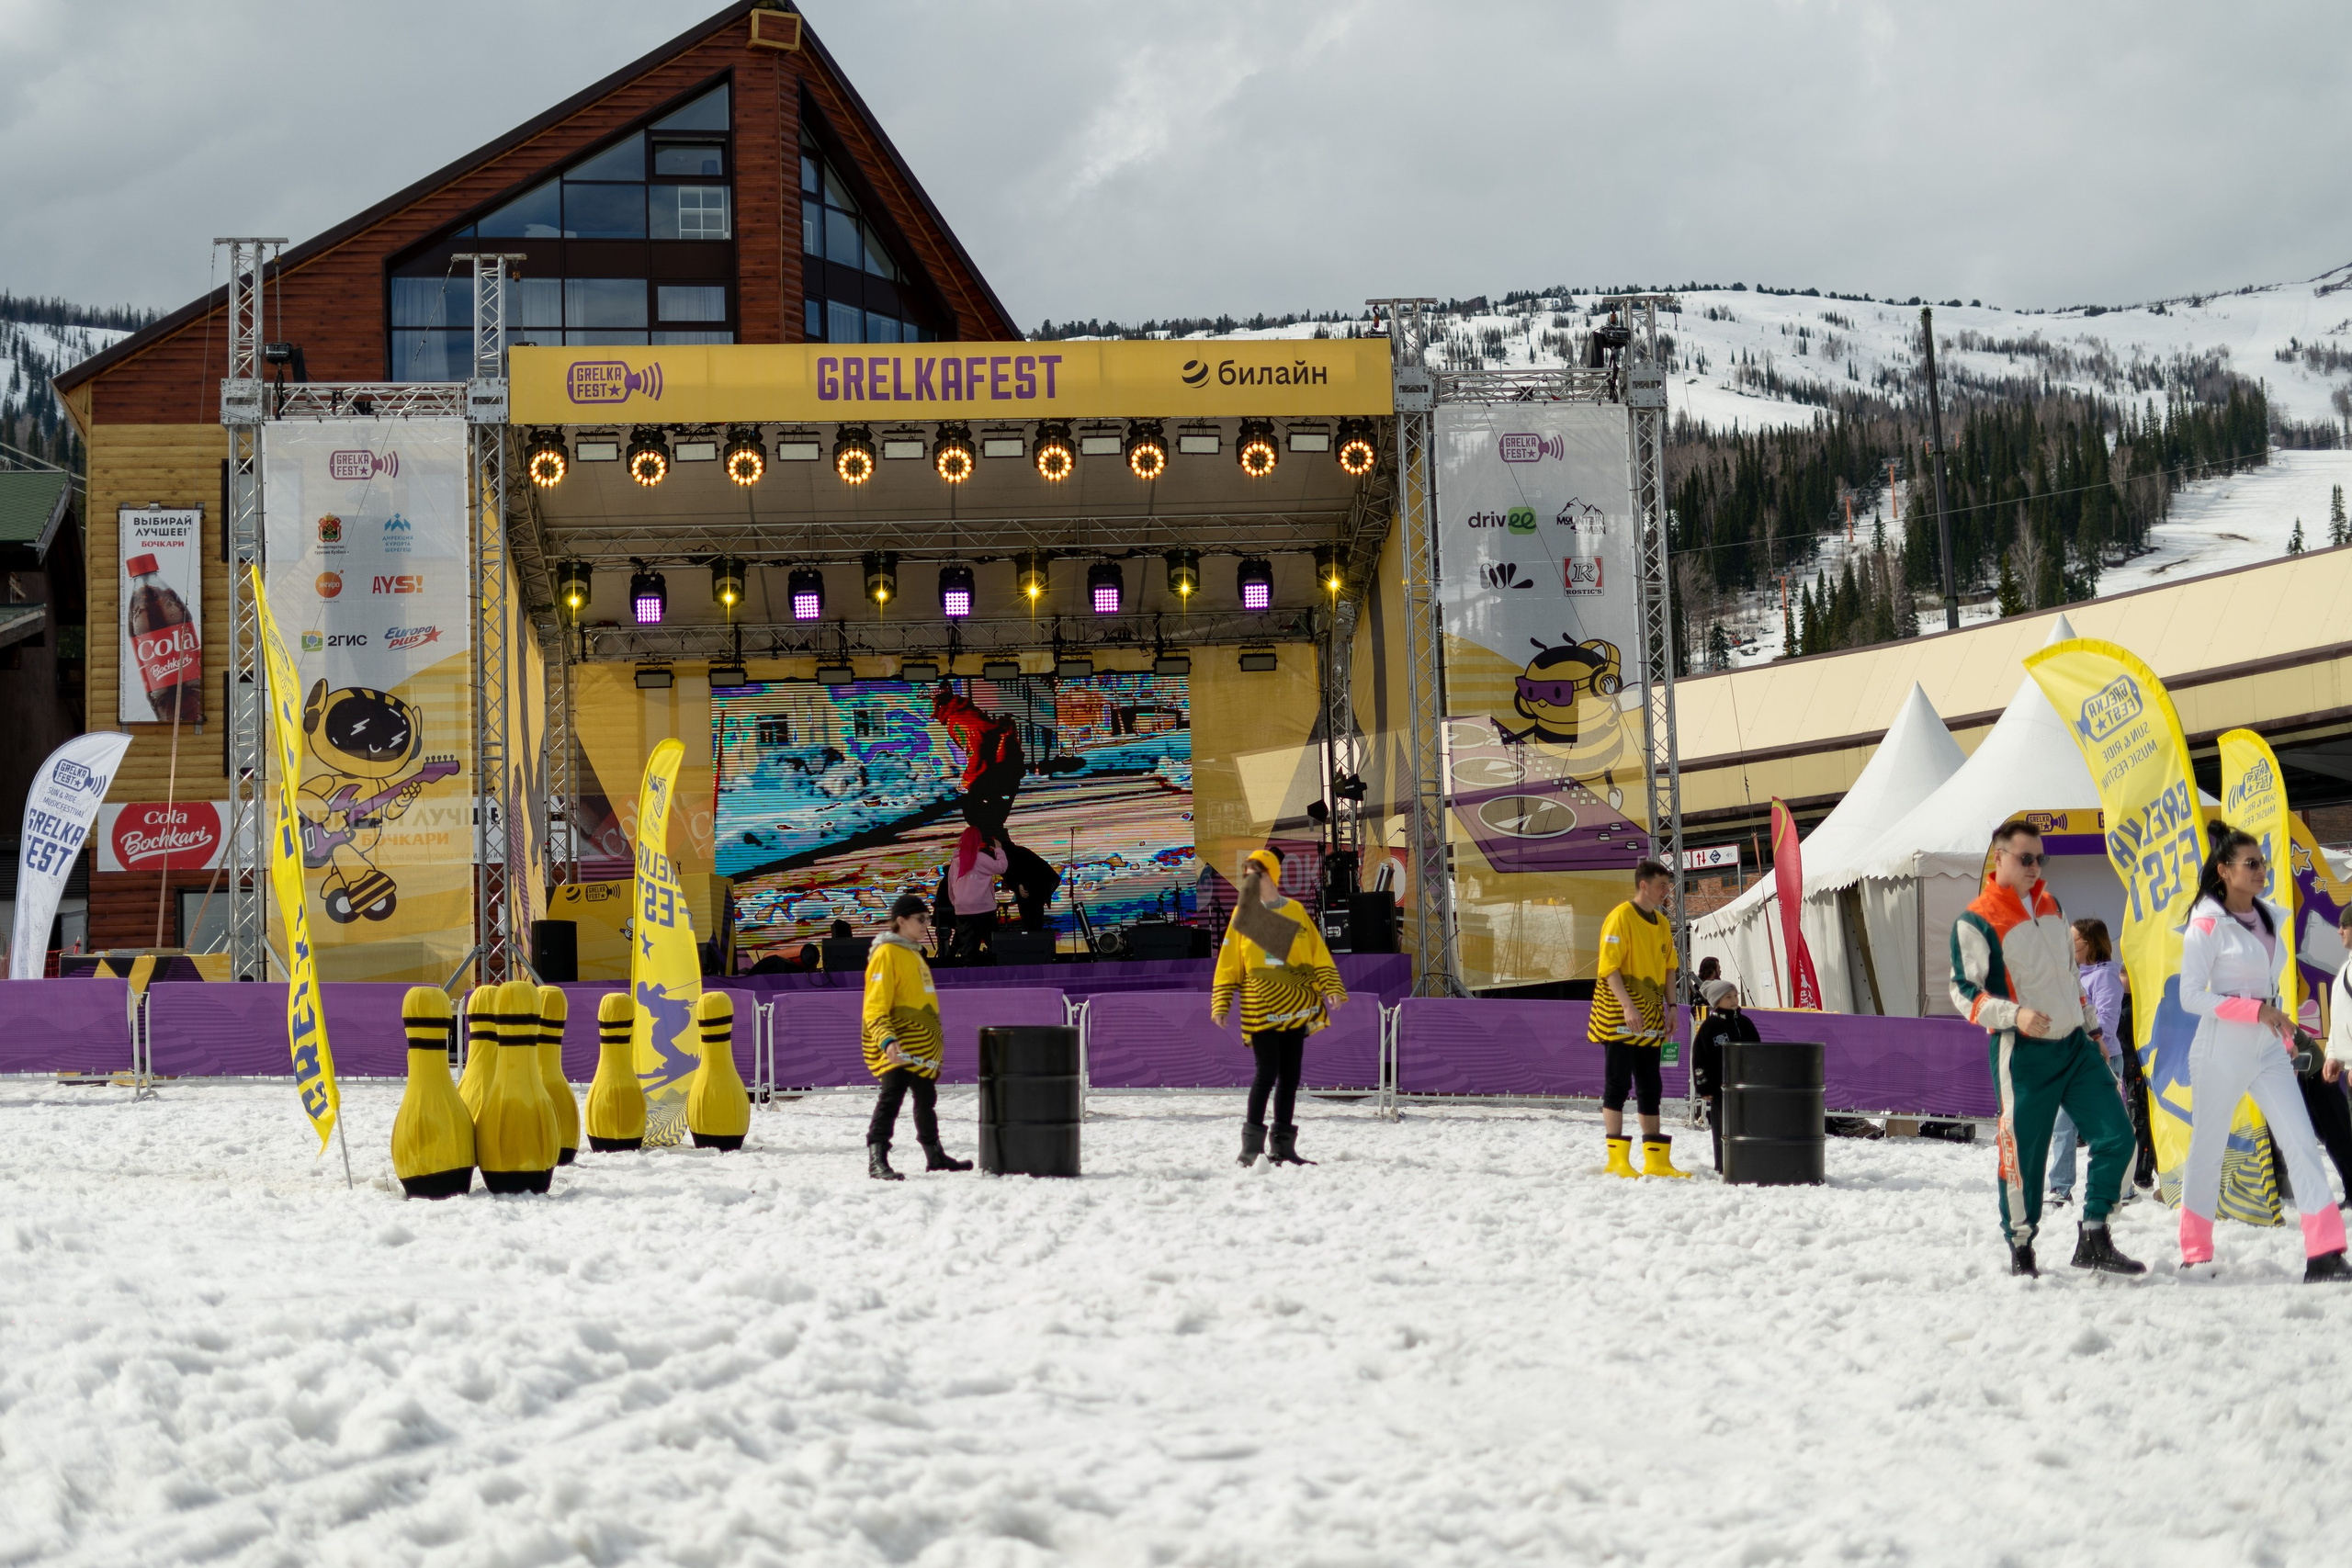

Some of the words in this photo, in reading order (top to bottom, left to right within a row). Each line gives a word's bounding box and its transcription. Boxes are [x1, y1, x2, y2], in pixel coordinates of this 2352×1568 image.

[577, 367, 621, 381] GRELKA
[817, 355, 1062, 401] GRELKAFEST
[1218, 359, 1328, 386] билайн
[577, 383, 607, 397] FEST
[1505, 437, 1536, 447] GRELKA
[336, 454, 369, 464] GRELKA
[1506, 448, 1526, 458] FEST
[336, 466, 358, 476] FEST
[133, 515, 192, 525] ВЫБИРАЙ
[1468, 511, 1536, 529] drivee
[372, 575, 424, 594] AYS!
[138, 630, 196, 661] Cola
[327, 635, 368, 647] 2ГИС
[56, 773, 75, 784] FEST
[60, 762, 87, 779] GRELKA
[46, 786, 60, 797] SUN
[63, 793, 77, 804] RIDE
[59, 802, 85, 818] FESTIVAL
[143, 809, 188, 825] Cola
[119, 826, 213, 858] Bochkari
